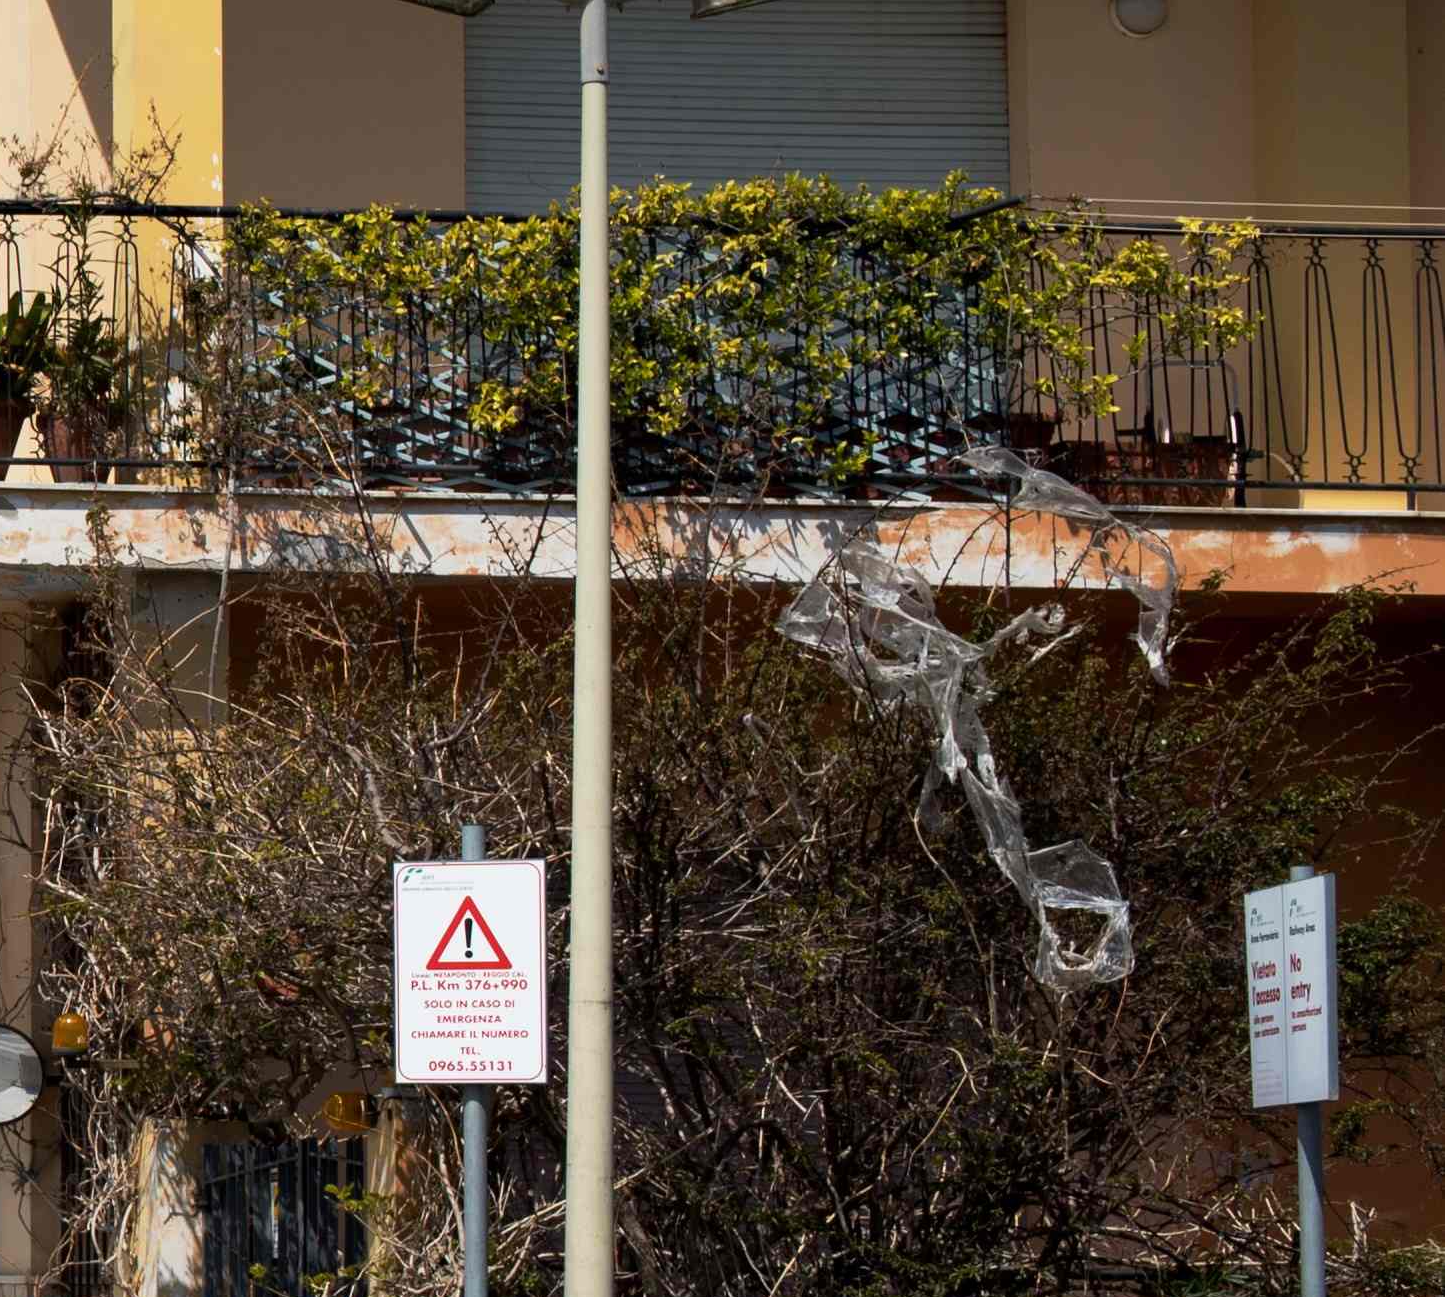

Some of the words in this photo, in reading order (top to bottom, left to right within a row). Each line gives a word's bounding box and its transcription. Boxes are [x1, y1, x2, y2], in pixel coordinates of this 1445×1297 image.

[1290, 953, 1301, 973] No
[411, 980, 432, 991] P.L.
[437, 980, 460, 991] Km
[465, 979, 528, 991] 376+990
[1291, 982, 1311, 1002] entry
[424, 999, 452, 1009] SOLO
[456, 999, 467, 1008] IN
[471, 999, 501, 1008] CASO
[504, 999, 515, 1008] DI
[437, 1015, 502, 1023] EMERGENZA
[411, 1030, 466, 1039] CHIAMARE
[469, 1030, 478, 1039] IL
[481, 1030, 529, 1038] NUMERO
[461, 1046, 481, 1055] TEL.
[429, 1060, 513, 1072] 0965.55131
